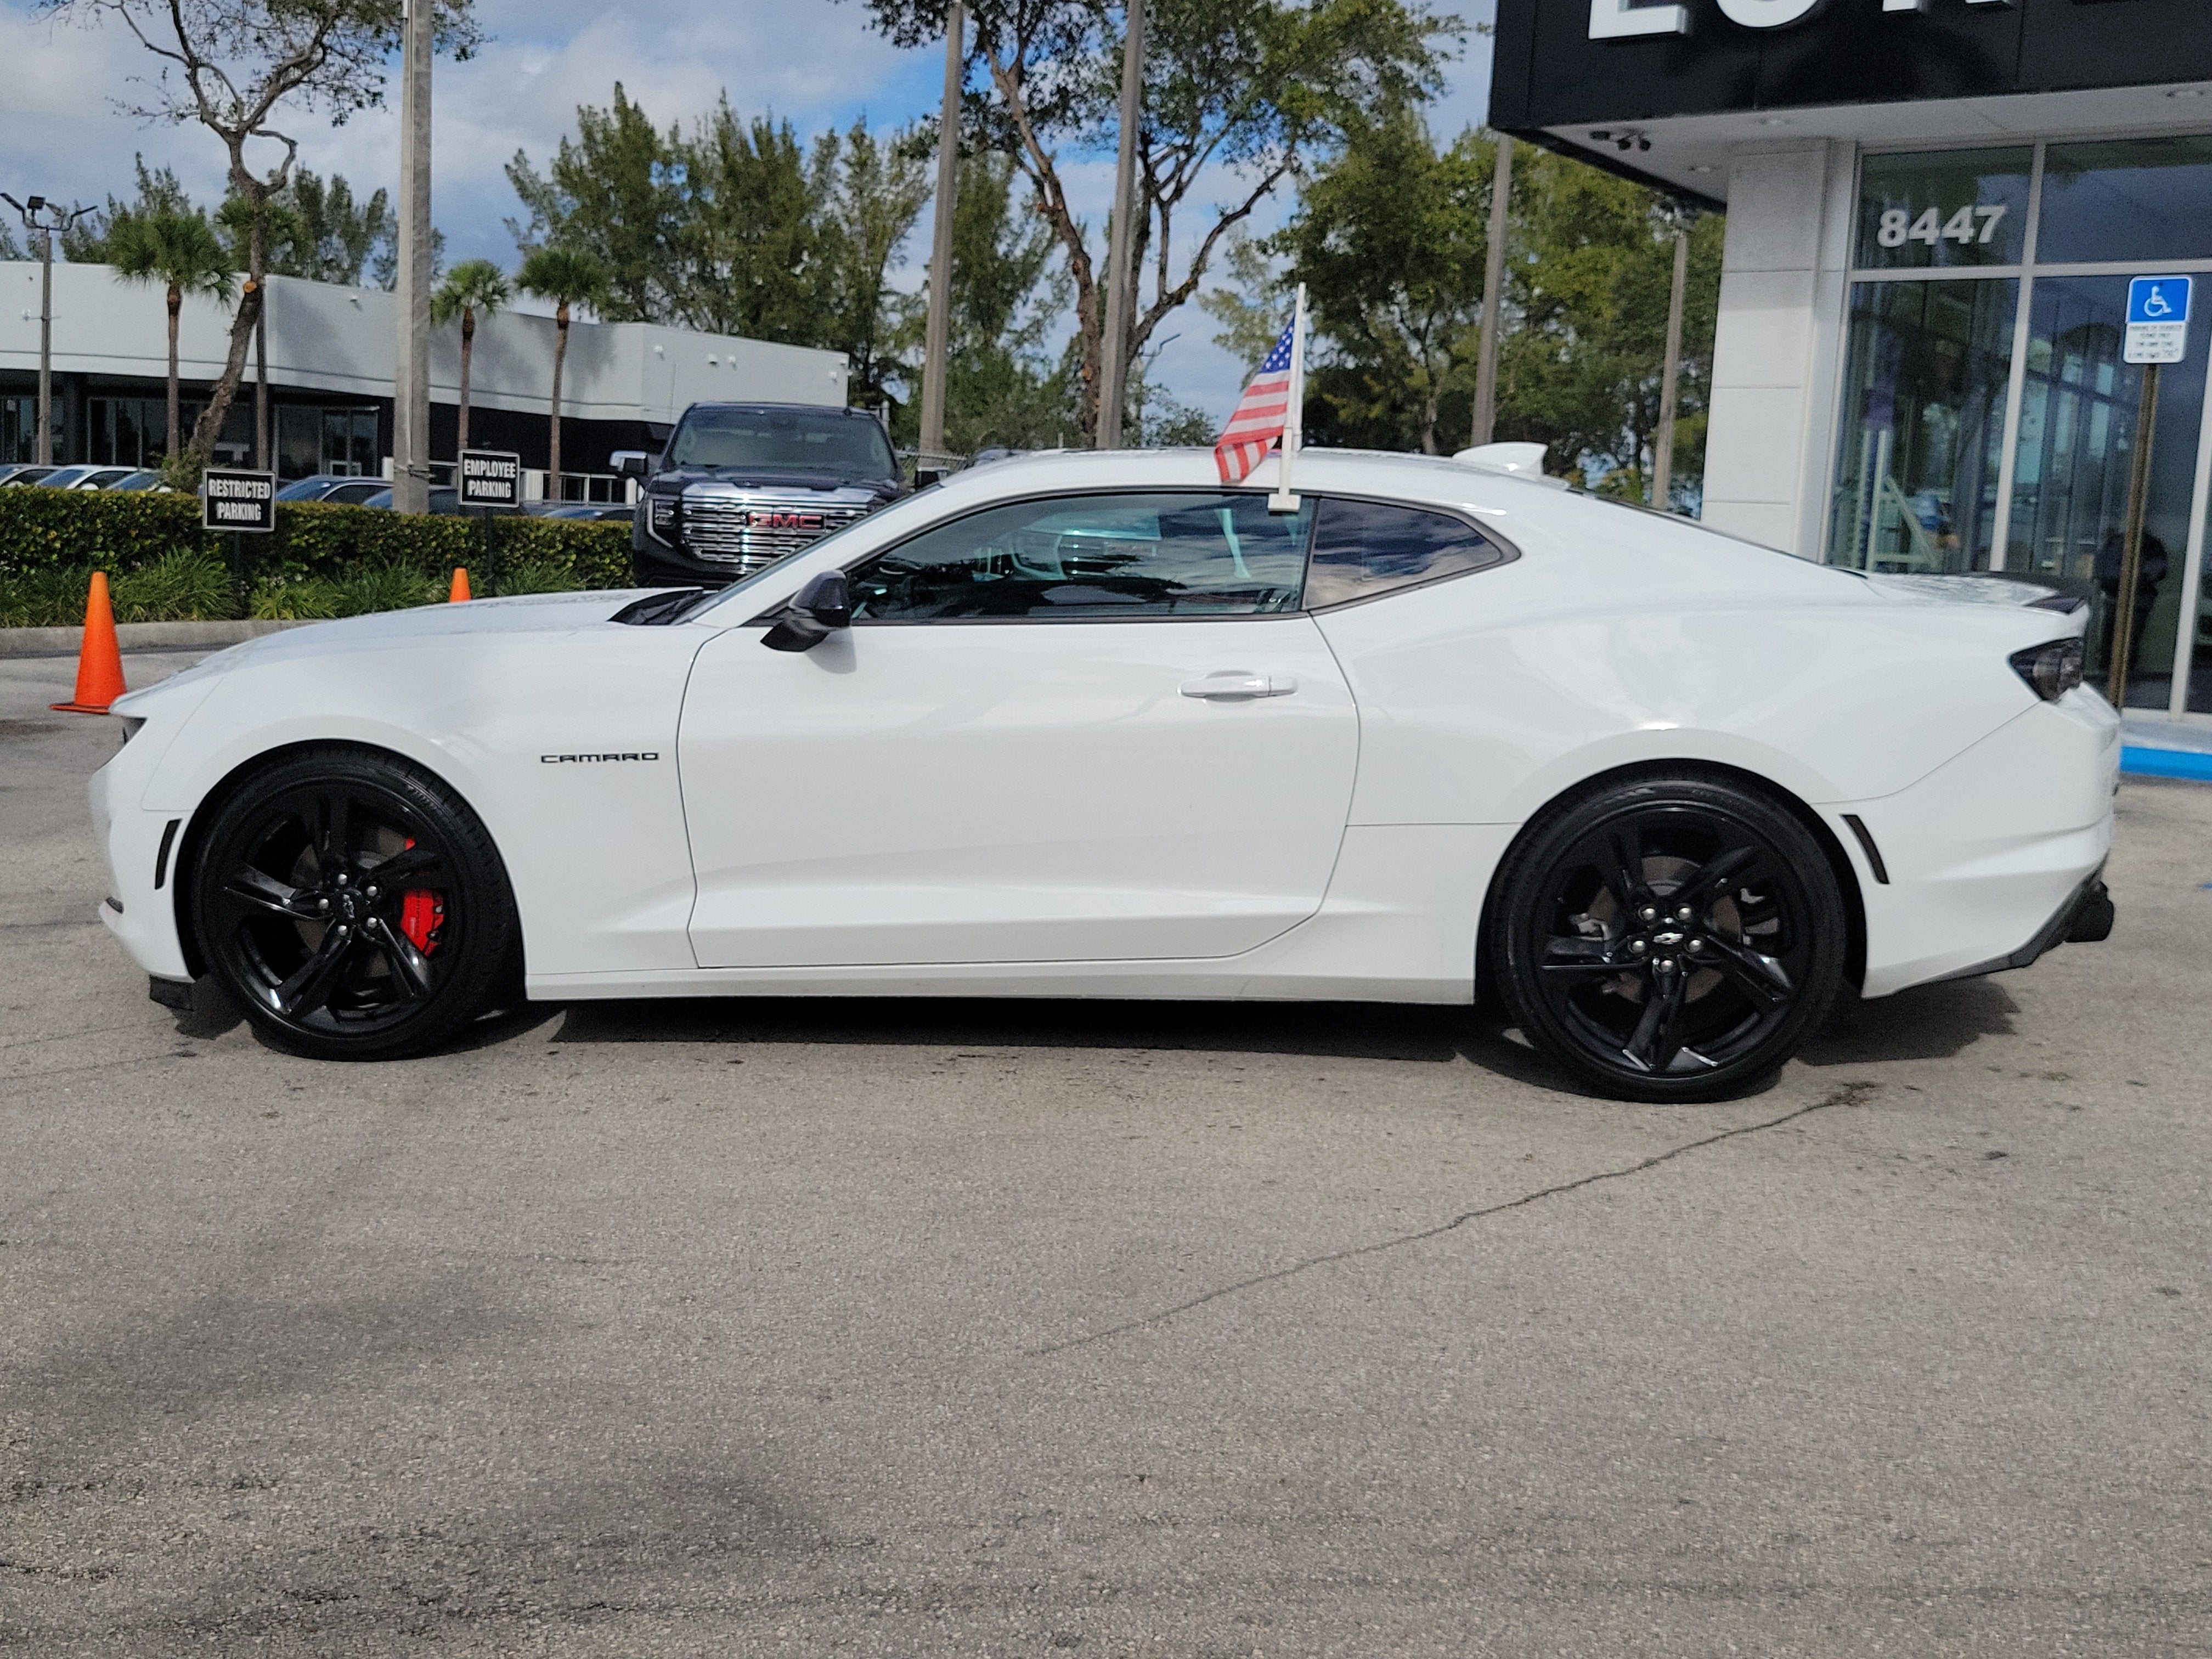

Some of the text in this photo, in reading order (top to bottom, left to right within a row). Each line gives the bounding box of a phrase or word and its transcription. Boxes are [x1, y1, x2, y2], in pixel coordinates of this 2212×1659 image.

[1877, 205, 2006, 247] 8447
[464, 459, 516, 478] EMPLOYEE
[208, 478, 271, 499] RESTRICTED
[467, 479, 511, 498] PARKING
[216, 501, 261, 521] PARKING
[748, 512, 822, 528] GMC
[540, 753, 658, 763] CAMARO
